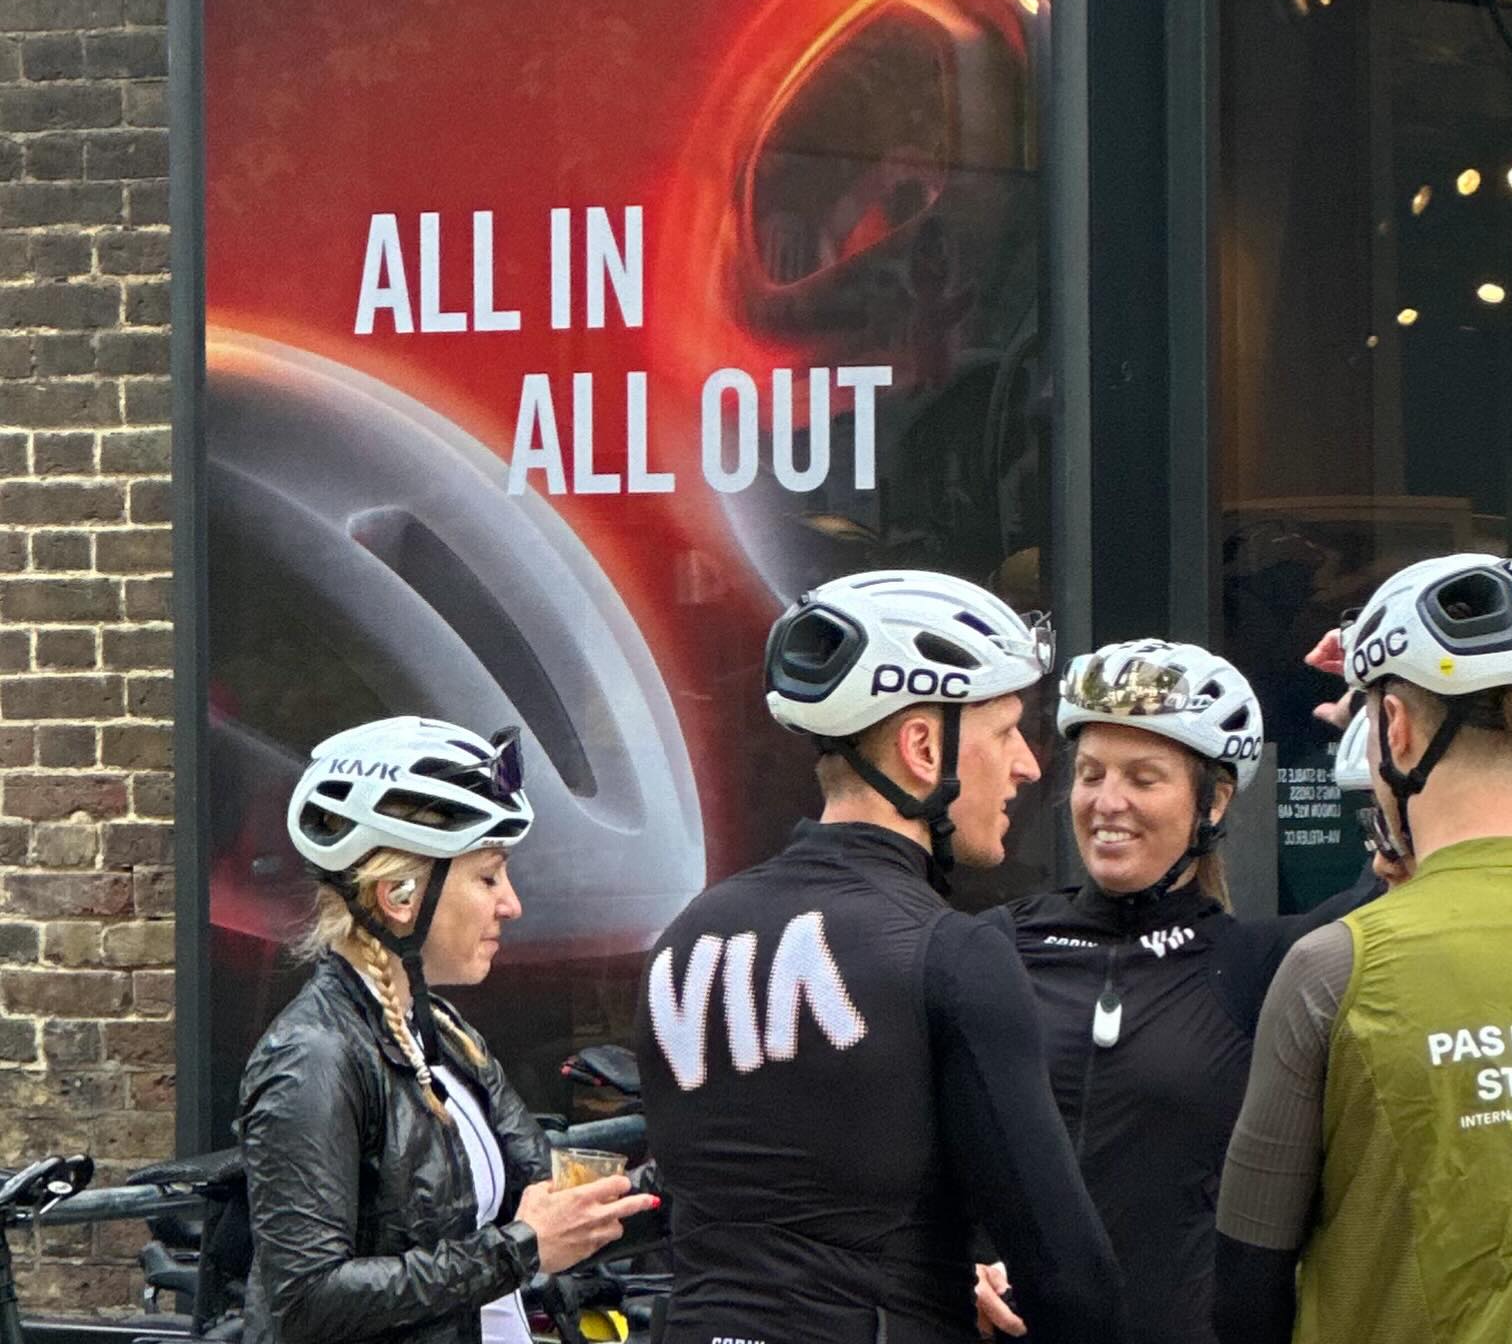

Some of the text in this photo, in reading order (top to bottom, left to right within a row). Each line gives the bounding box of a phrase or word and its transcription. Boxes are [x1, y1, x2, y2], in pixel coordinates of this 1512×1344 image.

[354, 206, 644, 335] ALL IN
[508, 365, 892, 496] ALL OUT
[329, 759, 401, 782] KASK
[648, 912, 868, 1091] VIA
[1428, 1025, 1504, 1066] PAS
